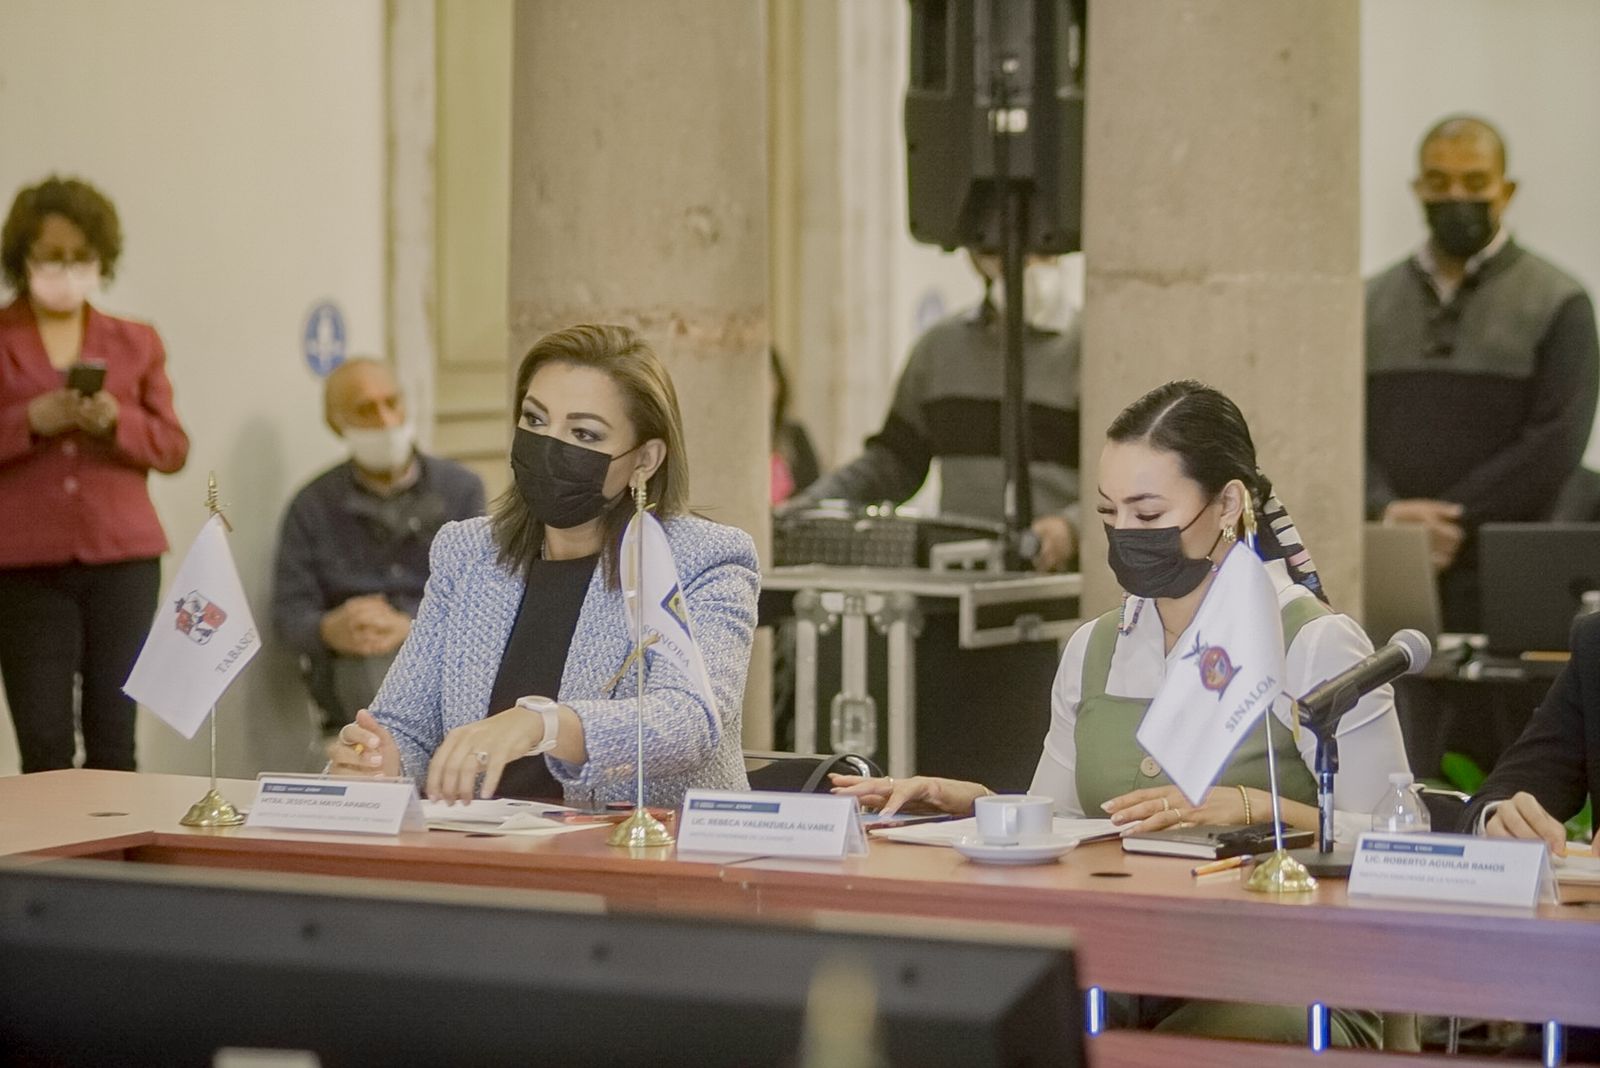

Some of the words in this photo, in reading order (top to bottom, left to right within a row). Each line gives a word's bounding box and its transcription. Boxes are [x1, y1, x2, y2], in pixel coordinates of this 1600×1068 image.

[641, 624, 690, 667] SONORA
[1224, 674, 1277, 733] SINALOA
[691, 818, 706, 826] LIC.
[707, 819, 741, 828] REBECA
[742, 821, 795, 831] VALENZUELA
[1364, 855, 1380, 864] LIC.
[1383, 857, 1428, 867] ROBERTO
[1429, 859, 1470, 870] AGUILAR
[1471, 862, 1506, 873] RAMOS
